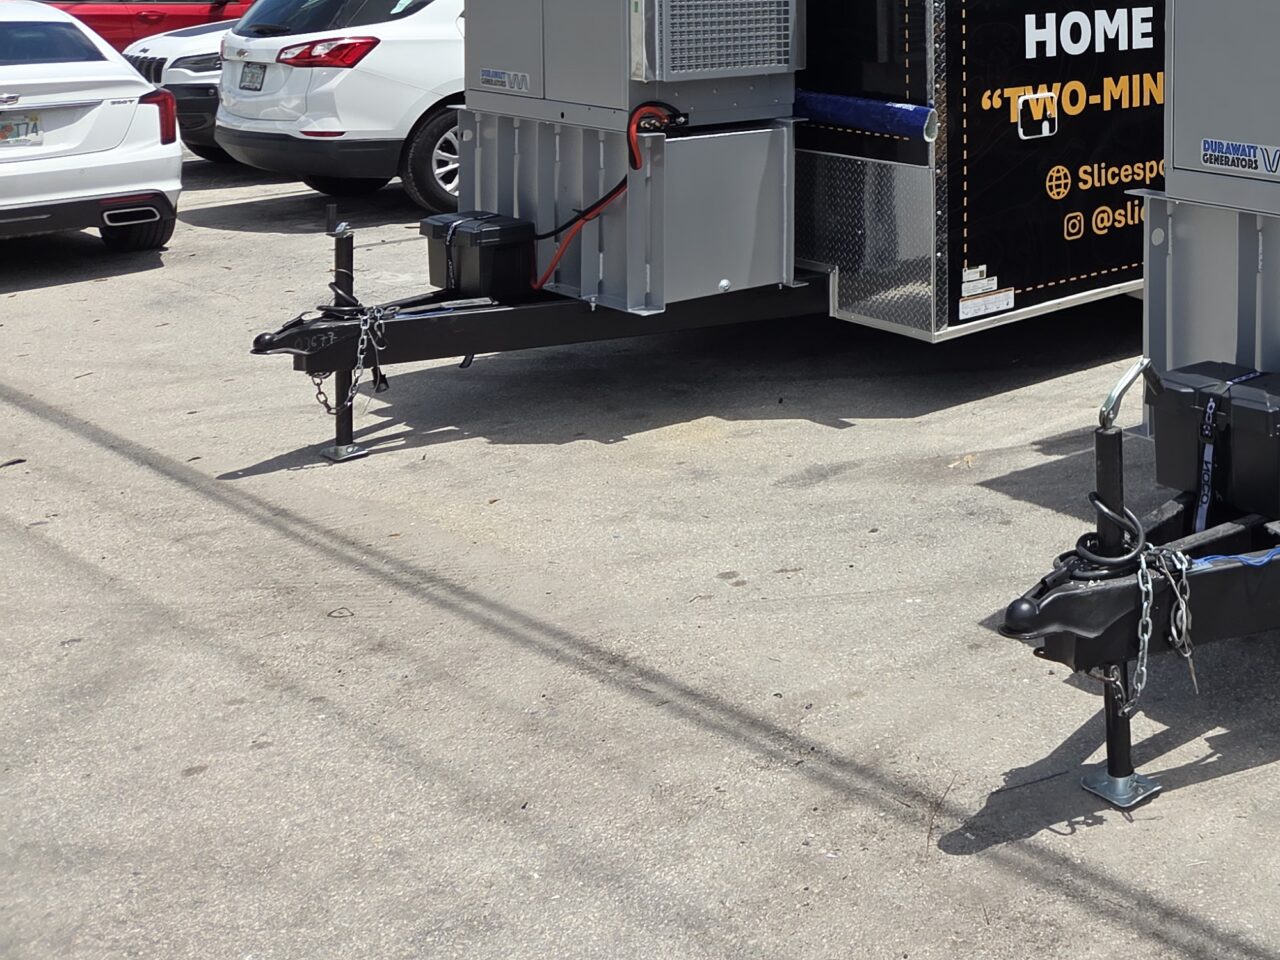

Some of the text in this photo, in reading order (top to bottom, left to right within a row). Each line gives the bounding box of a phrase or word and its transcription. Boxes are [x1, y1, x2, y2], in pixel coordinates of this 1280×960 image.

[1024, 6, 1154, 59] HOME
[1202, 152, 1259, 170] GENERATORS
[1203, 139, 1258, 159] DURAWATT
[1201, 460, 1212, 505] NOCO
